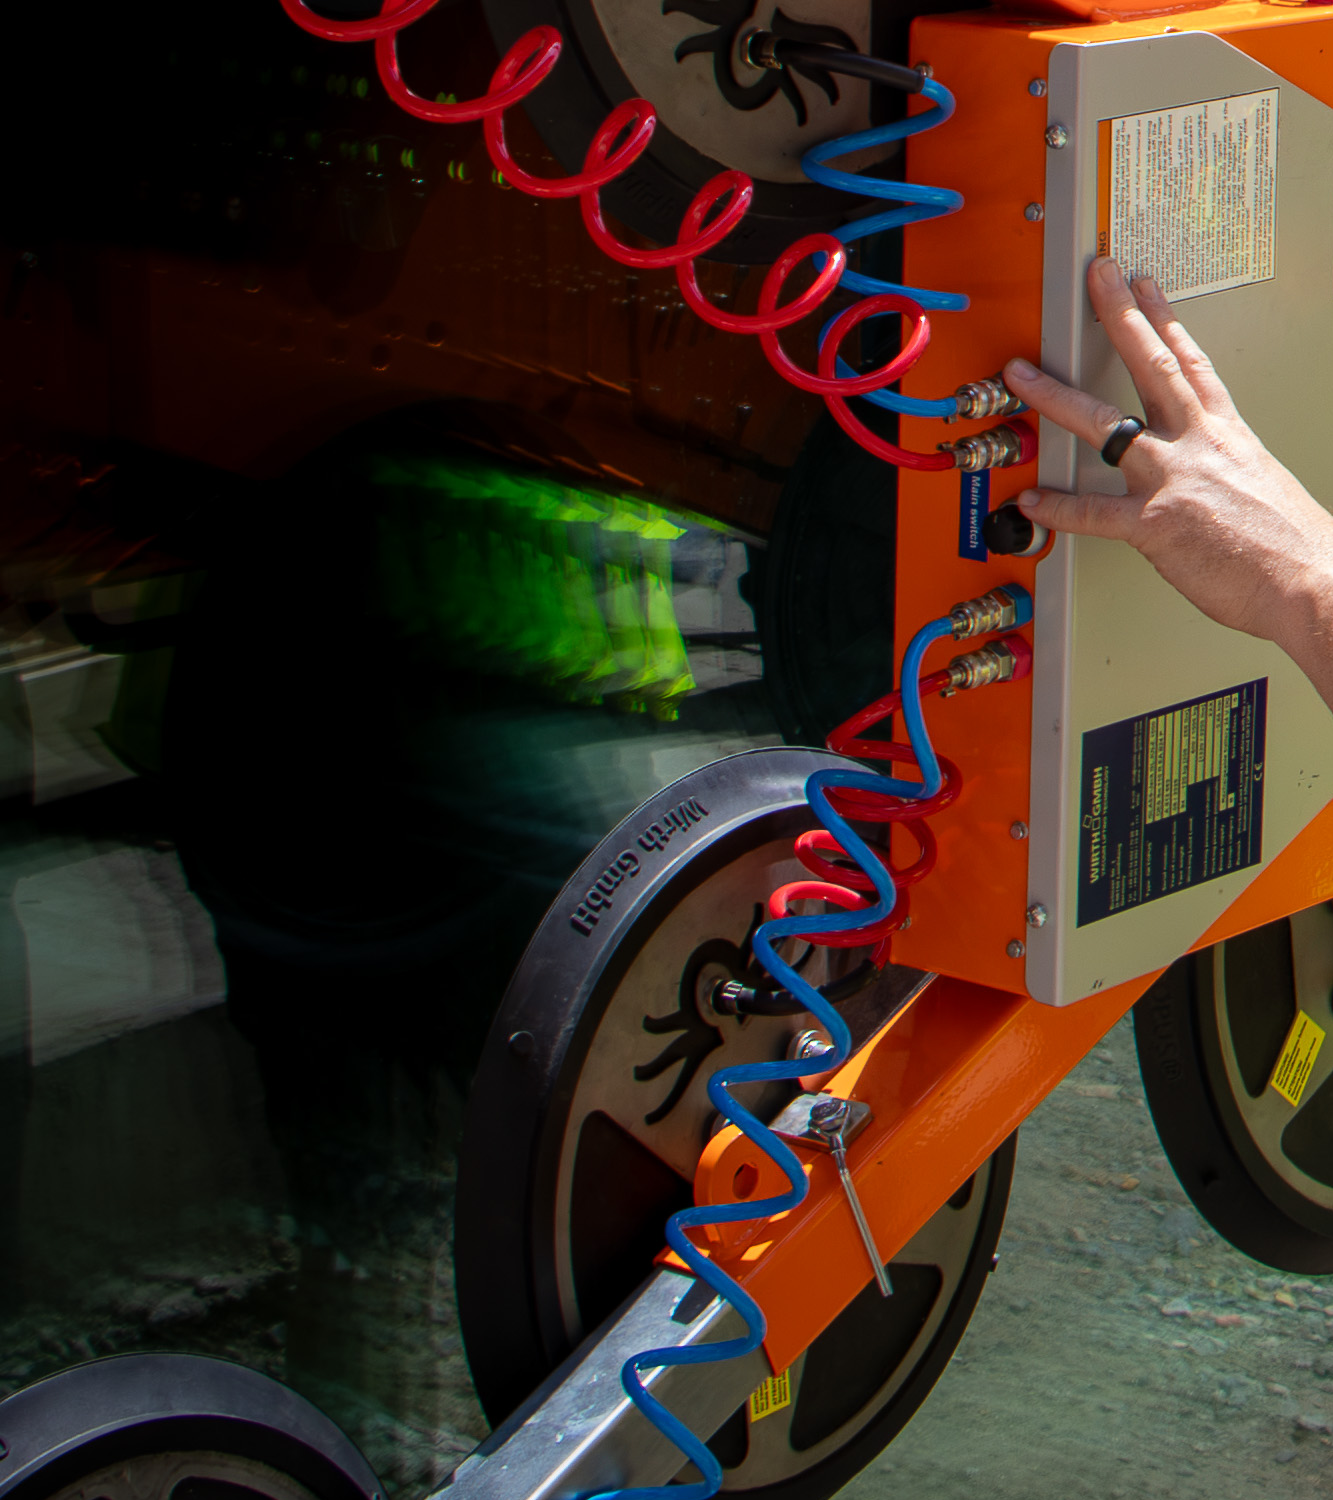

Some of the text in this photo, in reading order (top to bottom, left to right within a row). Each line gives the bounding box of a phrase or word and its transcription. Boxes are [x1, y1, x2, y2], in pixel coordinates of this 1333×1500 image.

[969, 475, 981, 549] Main switch
[570, 796, 709, 937] Wirth GmbH
[1090, 765, 1102, 883] WIRTH GMBH
